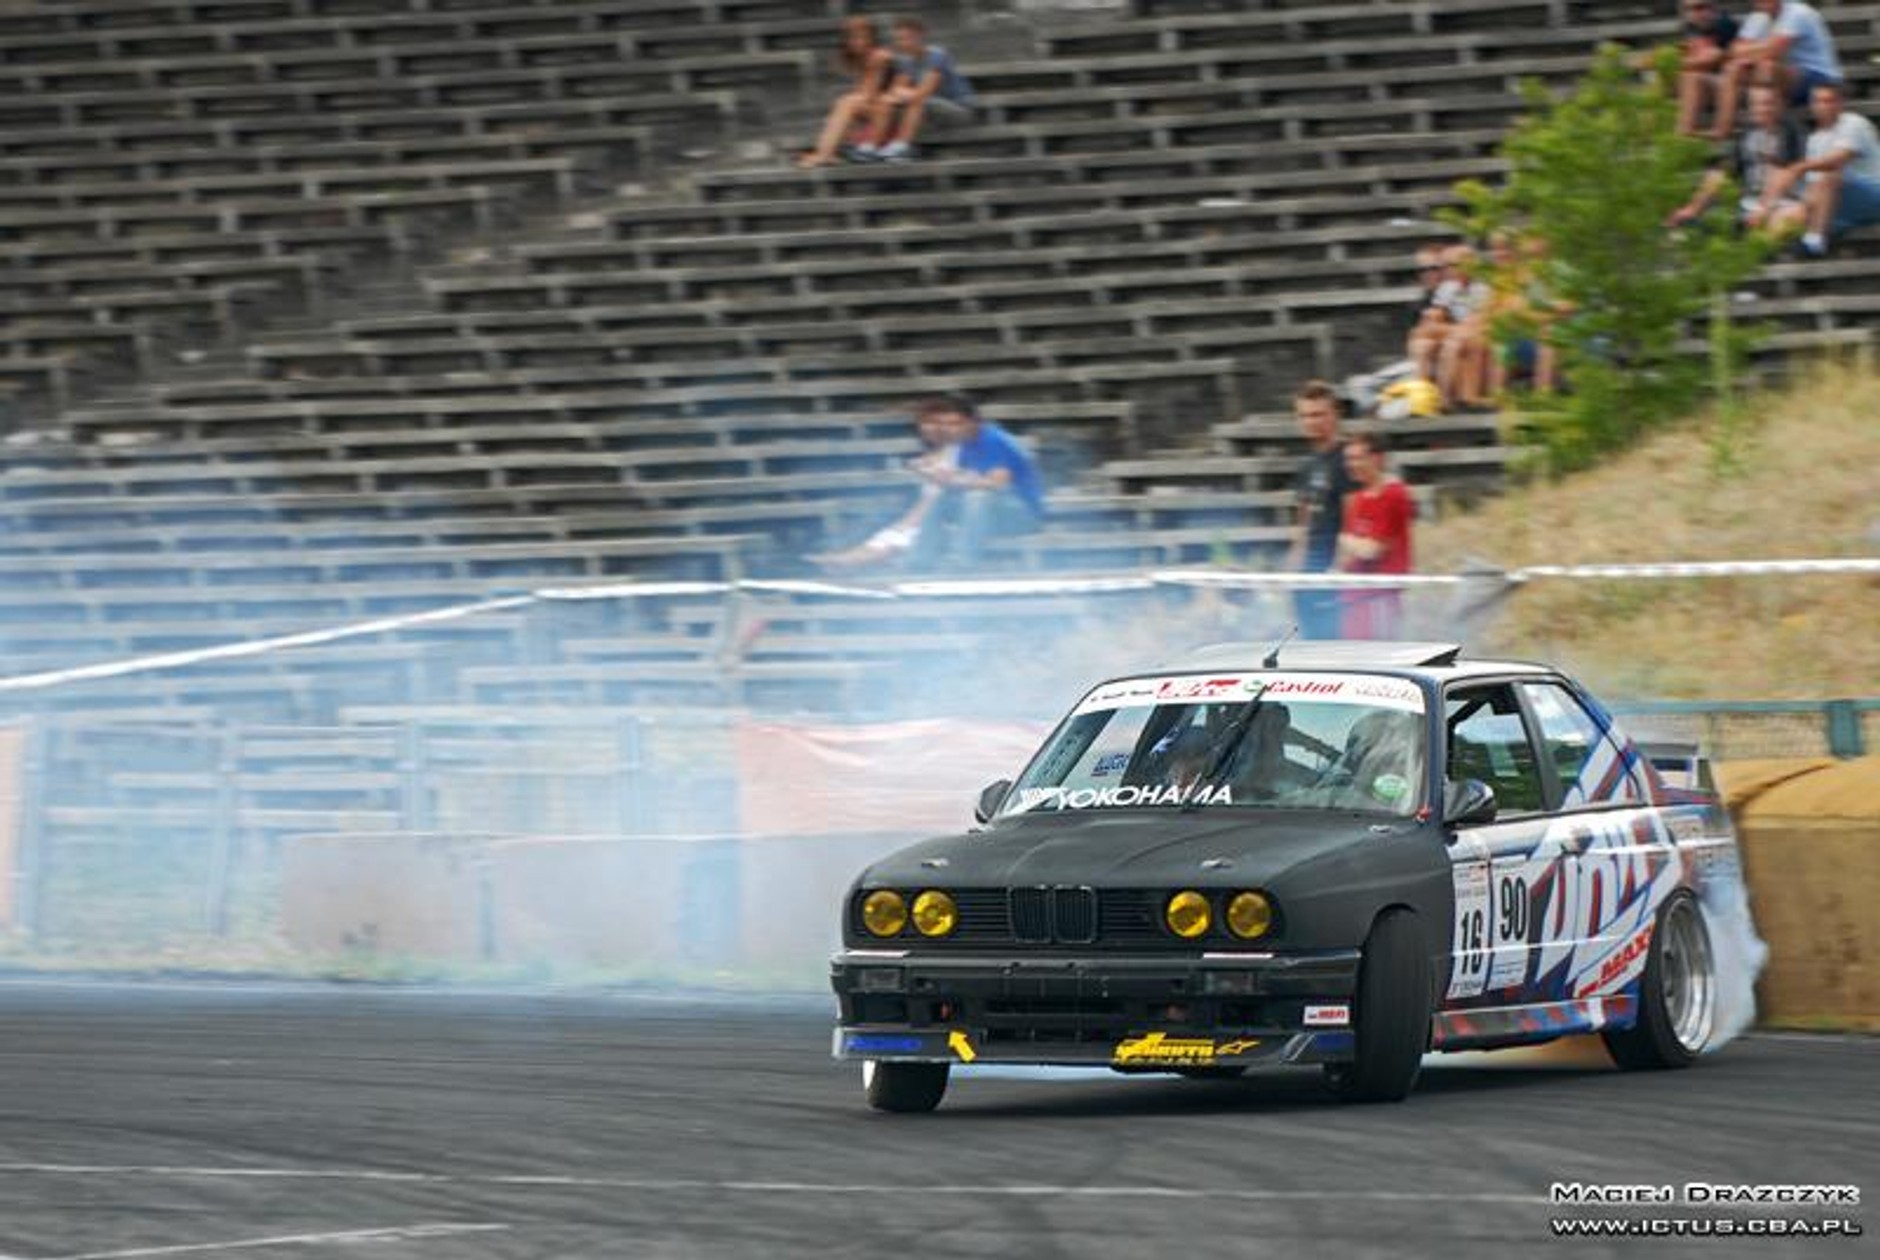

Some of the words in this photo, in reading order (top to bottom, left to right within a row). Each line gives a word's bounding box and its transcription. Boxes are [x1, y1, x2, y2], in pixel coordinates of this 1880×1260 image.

[1054, 785, 1233, 810] YOKOHAMA
[1500, 876, 1527, 941] 90
[1461, 908, 1483, 975] 16
